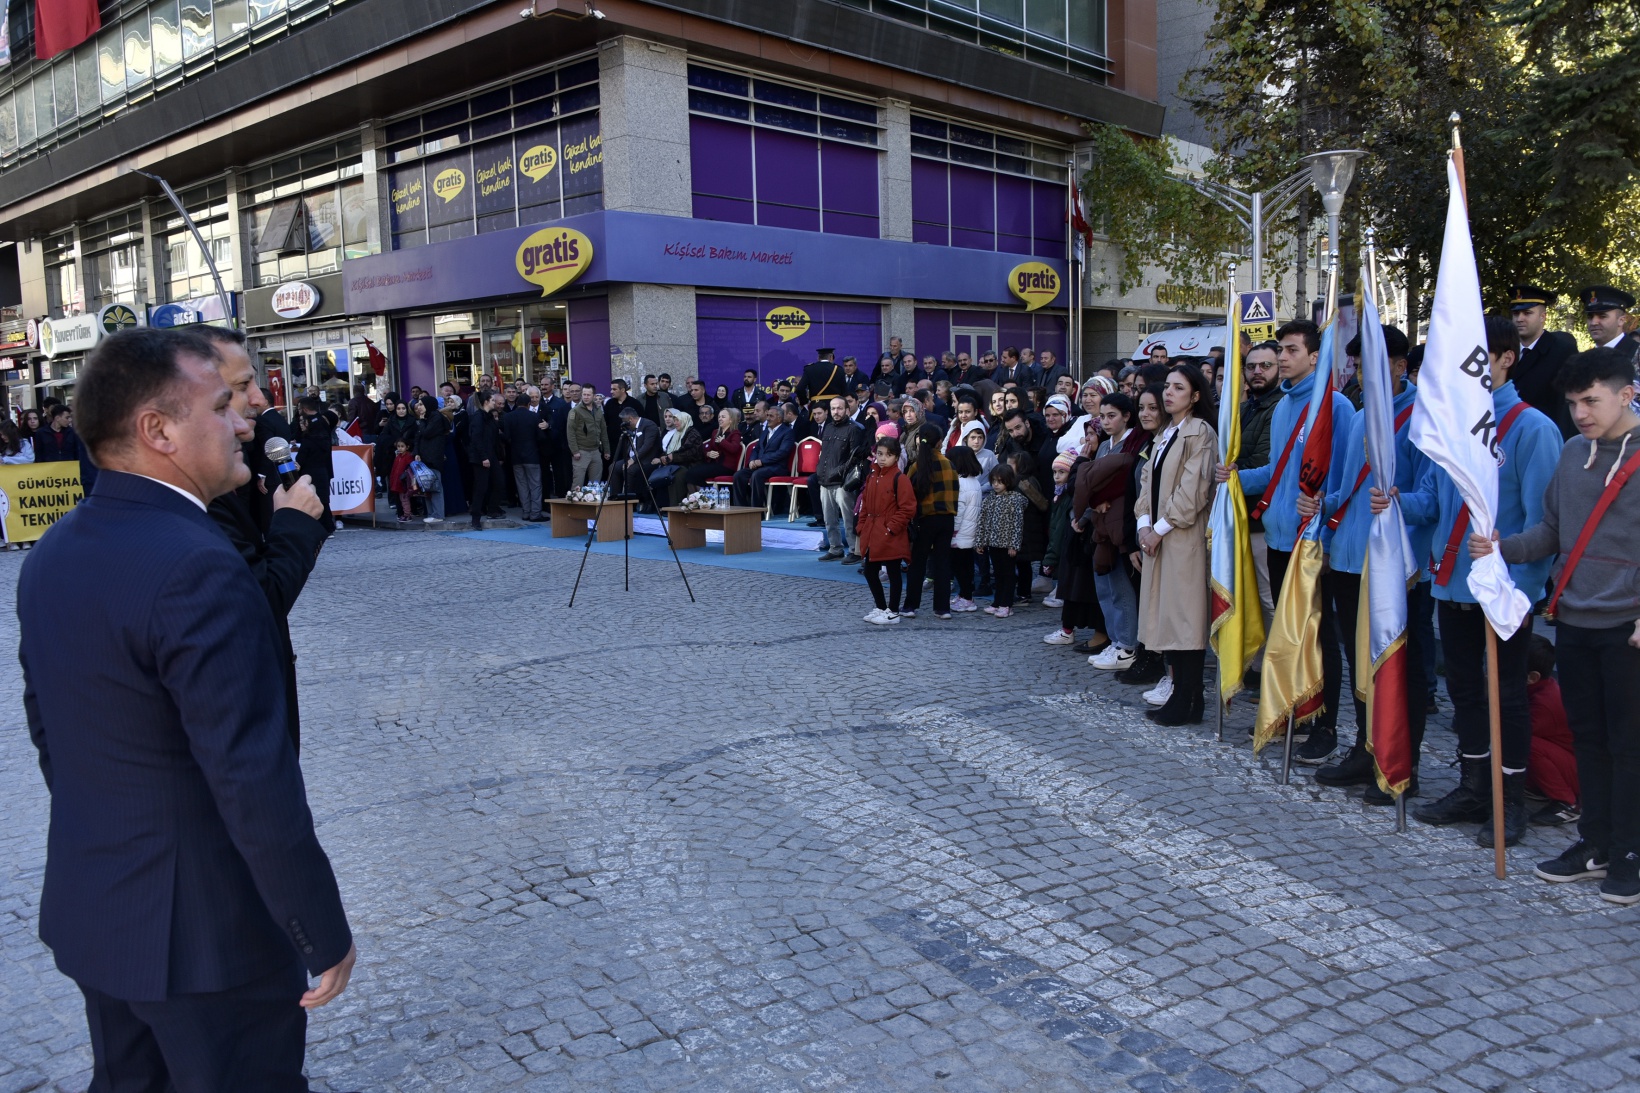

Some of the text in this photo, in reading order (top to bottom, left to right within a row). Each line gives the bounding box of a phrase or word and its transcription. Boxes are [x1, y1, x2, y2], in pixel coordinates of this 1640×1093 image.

[564, 135, 602, 160] Güzel ba
[476, 156, 512, 184] Güzel bak
[524, 148, 552, 172] gratis
[569, 152, 602, 175] kendine
[409, 178, 422, 195] bak
[437, 171, 462, 194] gratis
[481, 176, 510, 197] kendine
[395, 196, 420, 215] kendine
[523, 232, 579, 276] gratis
[664, 242, 793, 265] Kişisel Bakım Marketi
[1018, 268, 1056, 294] gratis
[770, 310, 806, 330] gratis
[17, 476, 83, 490] GÜMÜŞHA
[337, 477, 365, 496] LİSESİ
[19, 490, 70, 509] KANUNİ
